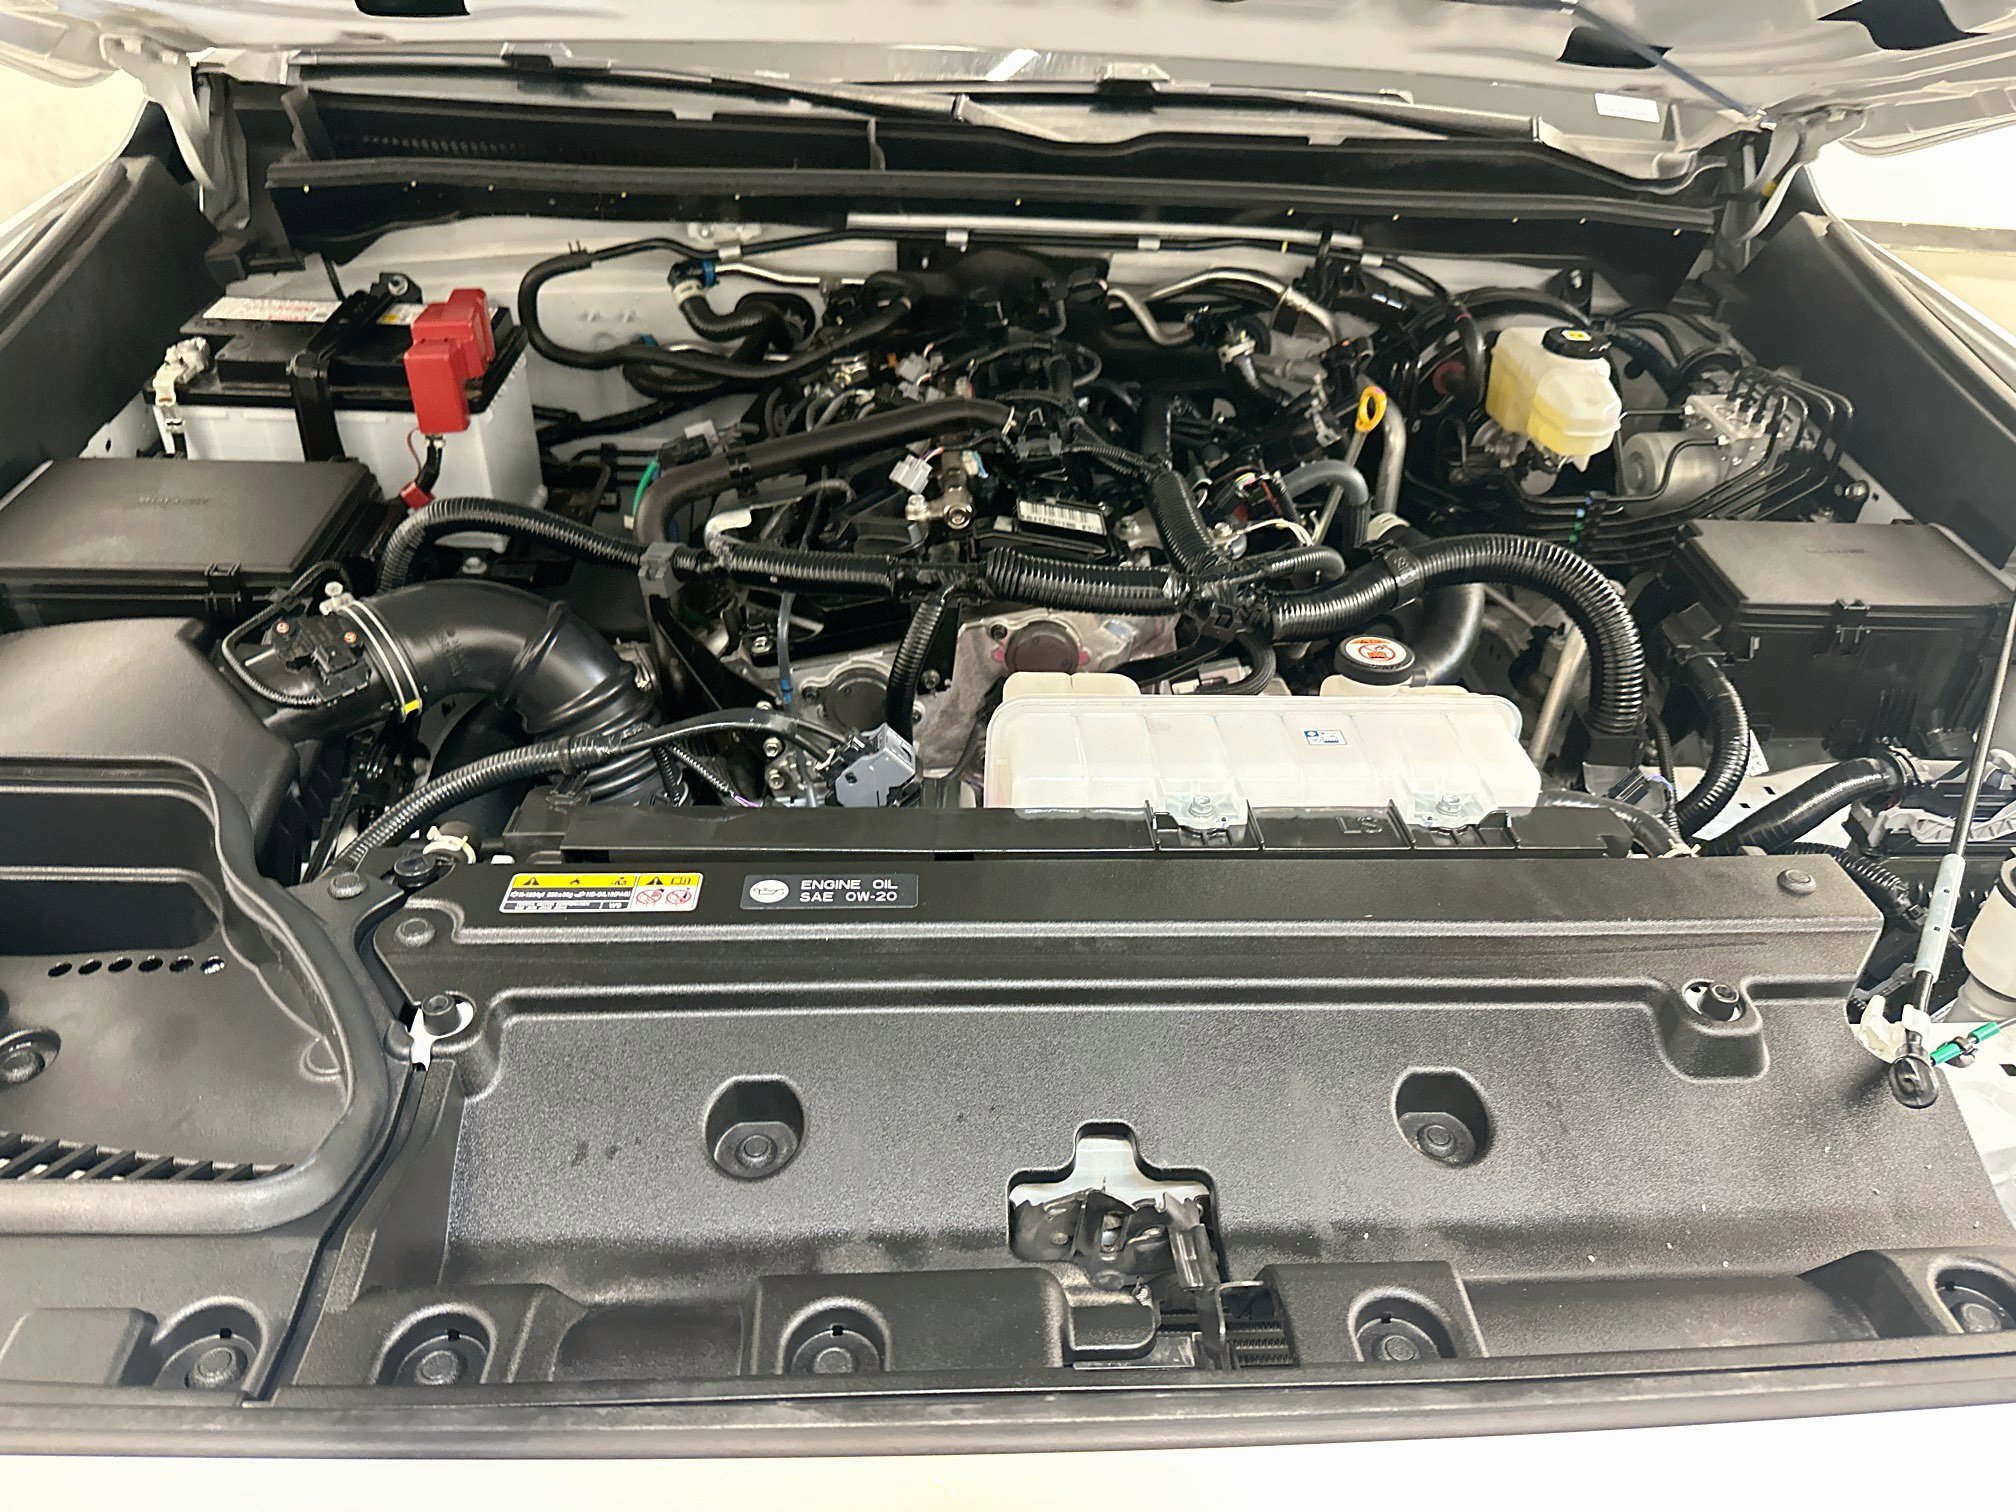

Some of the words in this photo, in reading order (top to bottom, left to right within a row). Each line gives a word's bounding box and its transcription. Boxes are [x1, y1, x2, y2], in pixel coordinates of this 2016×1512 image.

[800, 879, 861, 890] ENGINE
[872, 879, 899, 890] OIL
[799, 891, 834, 902] SAE
[845, 891, 898, 902] 0W-20
